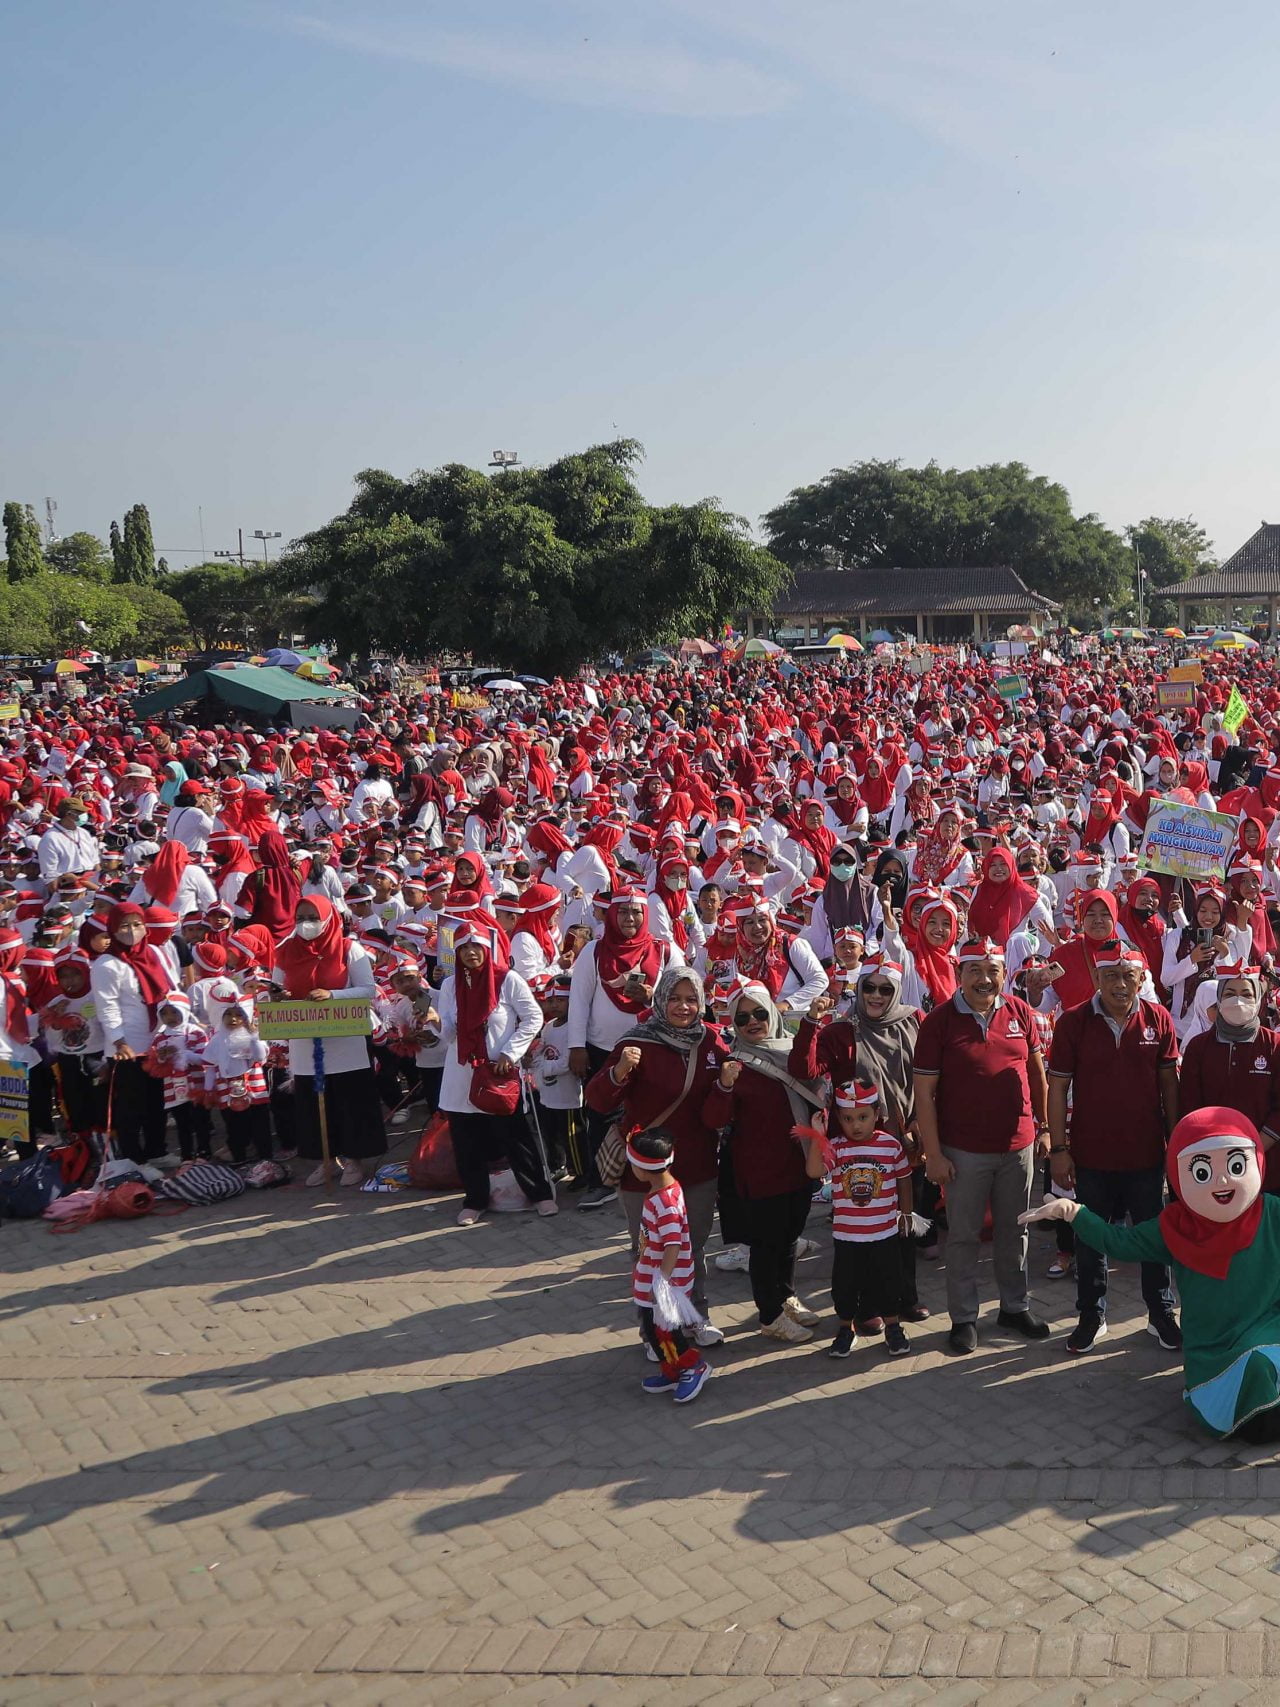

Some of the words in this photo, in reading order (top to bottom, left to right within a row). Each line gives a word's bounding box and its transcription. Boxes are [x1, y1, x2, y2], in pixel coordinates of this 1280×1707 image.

[1159, 820, 1174, 833] KB
[1174, 822, 1223, 843] AISYIYAH
[1148, 832, 1226, 857] MANGKUJAYAN
[260, 1008, 329, 1023] TK.MUSLIMAT
[333, 1007, 348, 1020] NU
[351, 1006, 368, 1019] 001
